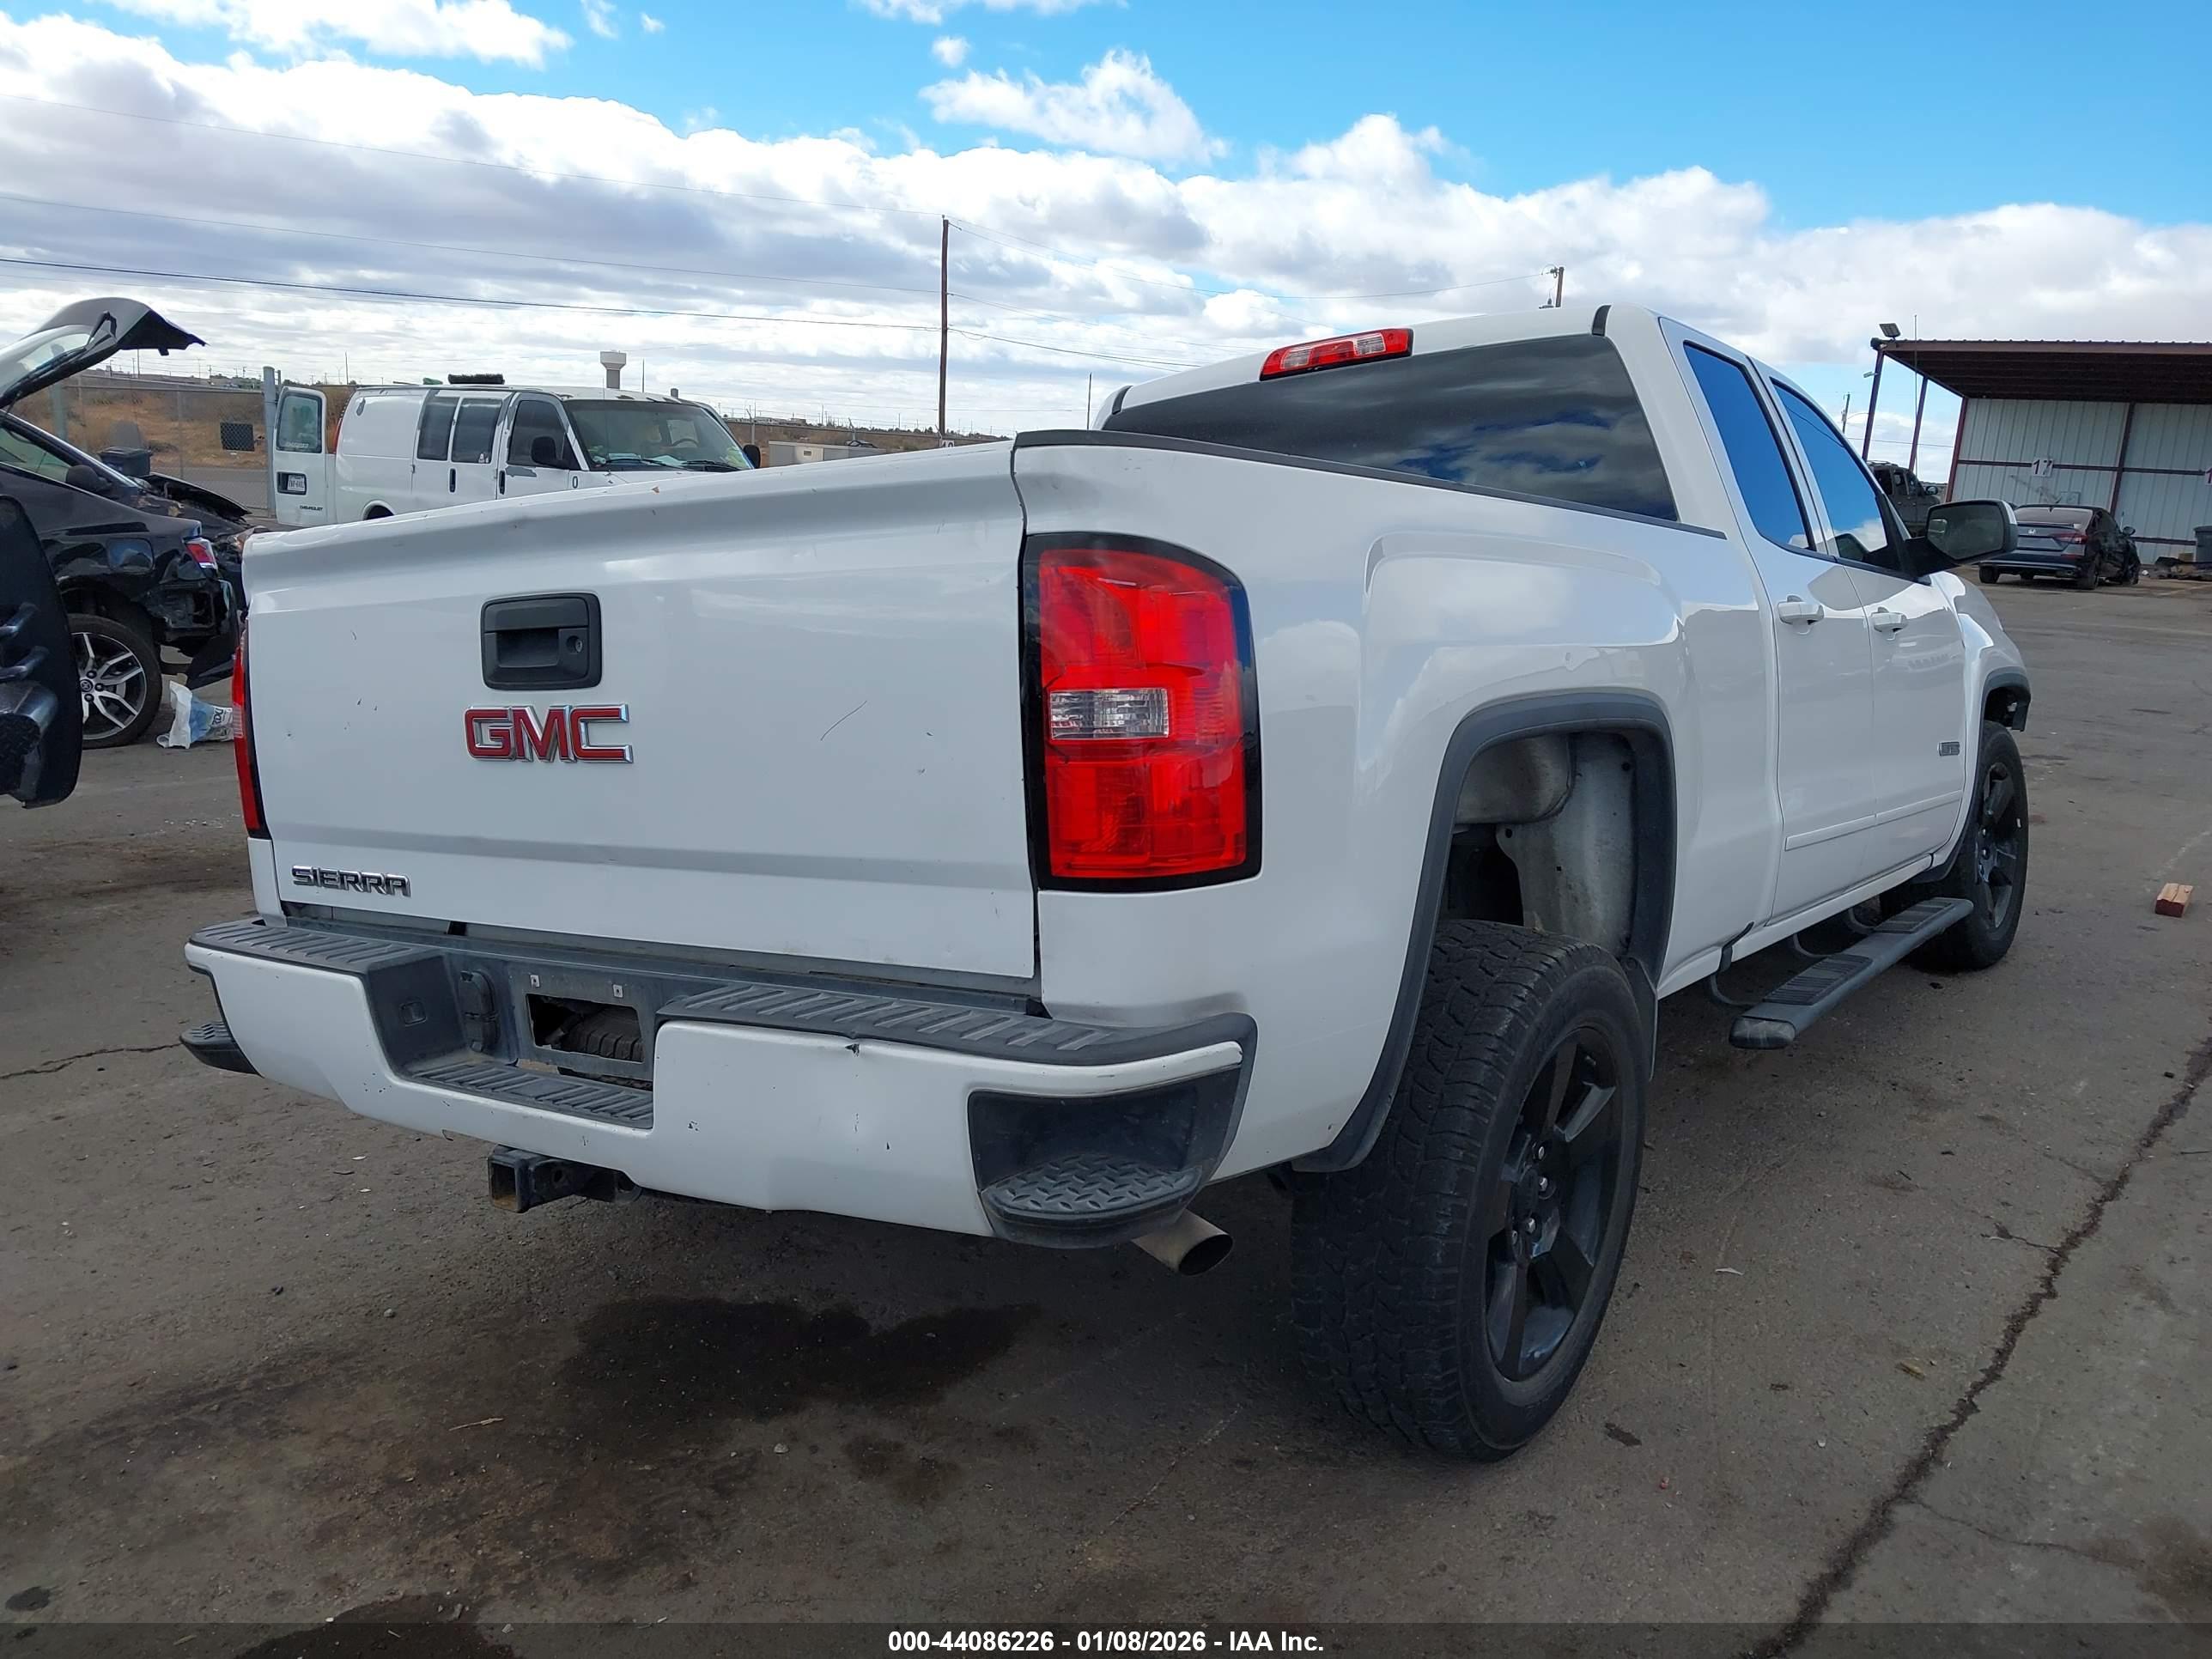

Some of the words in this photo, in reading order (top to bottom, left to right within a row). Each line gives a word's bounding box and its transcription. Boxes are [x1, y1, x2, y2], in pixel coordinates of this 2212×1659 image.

[2033, 459, 2052, 475] 17
[465, 704, 633, 763] GMC
[291, 865, 411, 897] SIERRA
